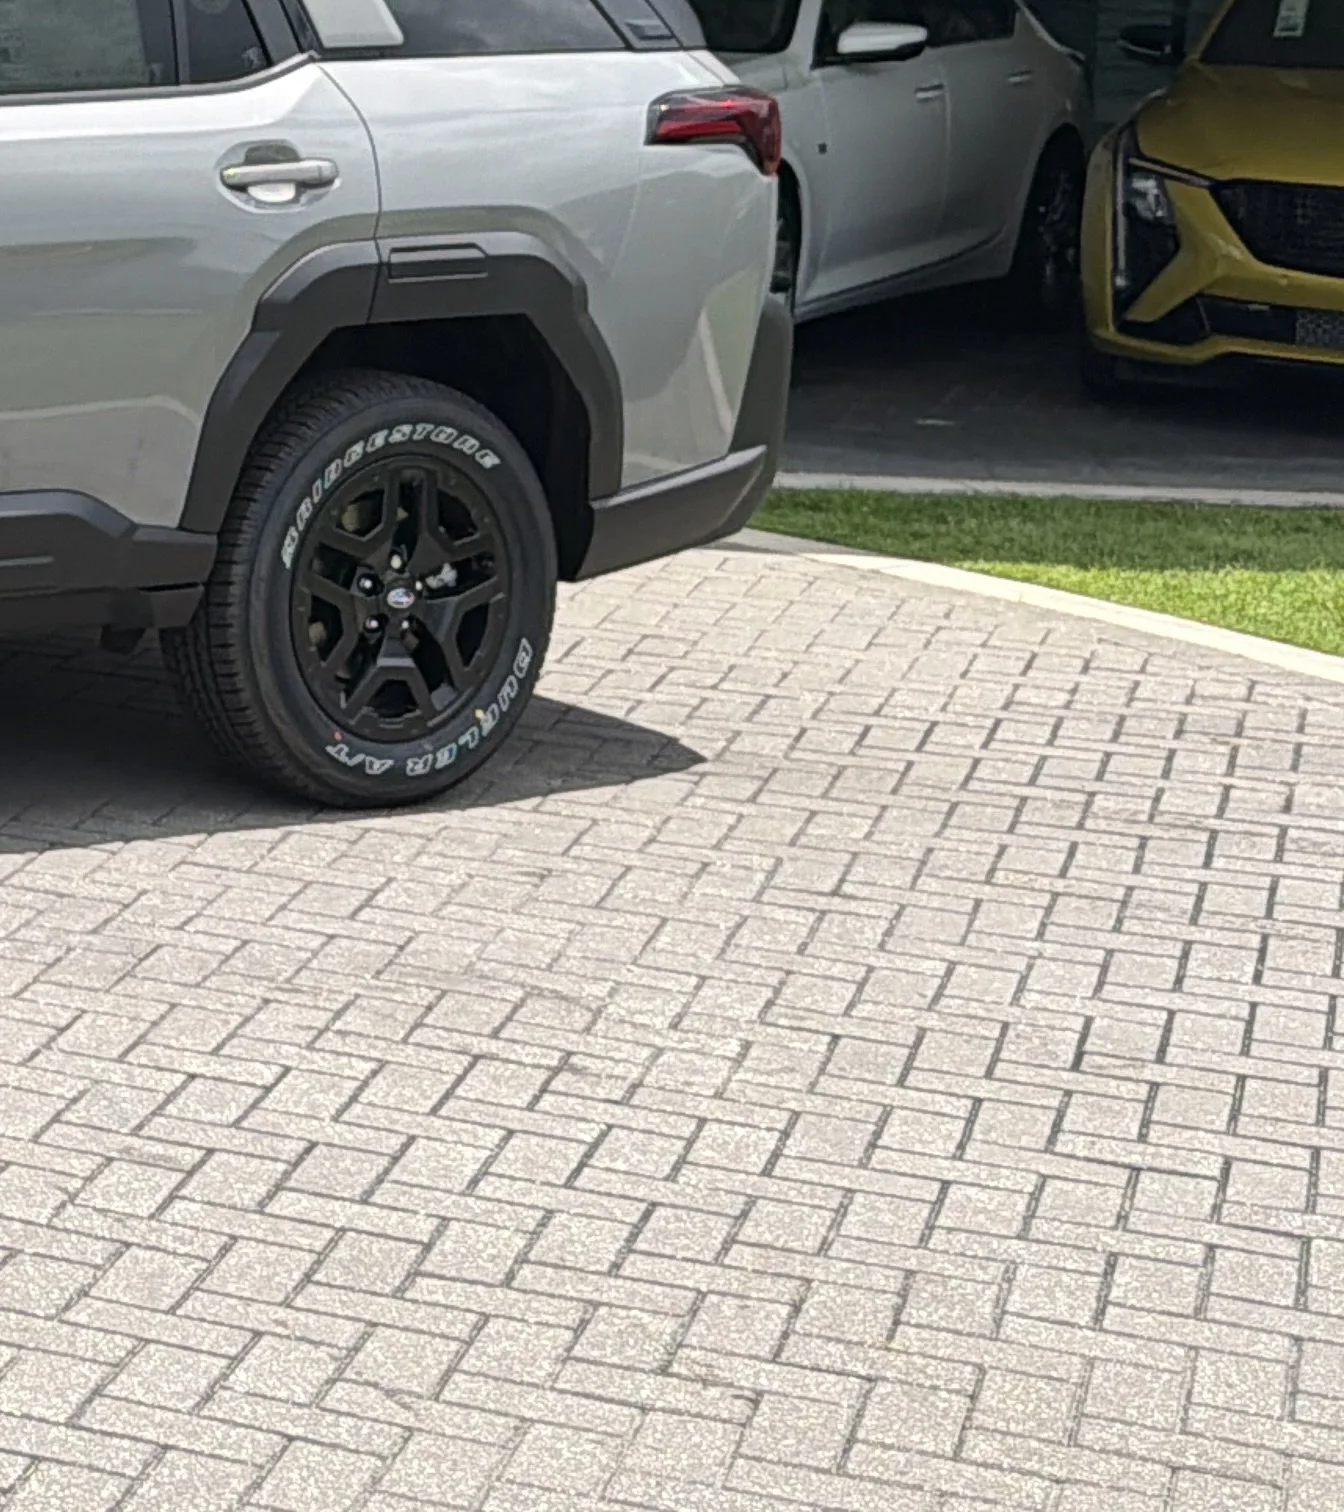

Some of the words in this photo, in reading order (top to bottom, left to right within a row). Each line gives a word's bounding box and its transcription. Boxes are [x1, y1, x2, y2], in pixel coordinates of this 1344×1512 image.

[279, 422, 503, 571] BRIDGESTONE
[325, 743, 391, 777] A/T
[406, 636, 534, 777] DUELER
